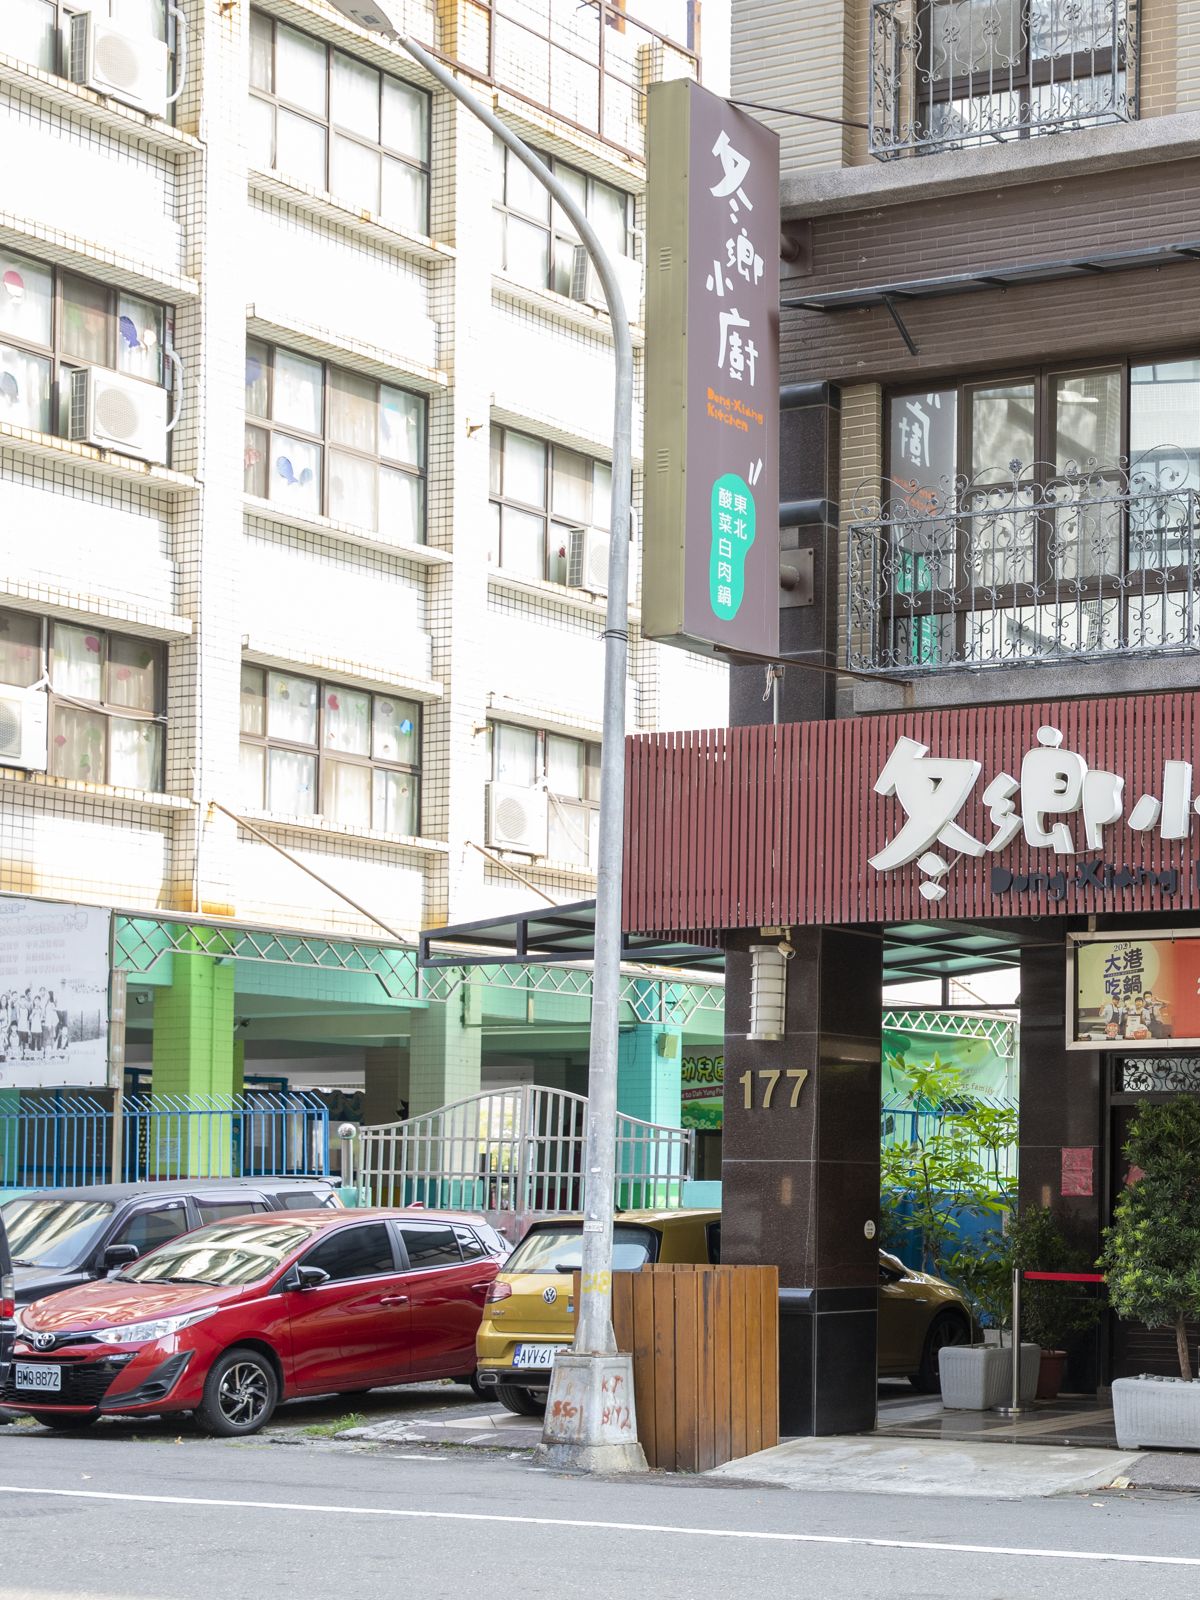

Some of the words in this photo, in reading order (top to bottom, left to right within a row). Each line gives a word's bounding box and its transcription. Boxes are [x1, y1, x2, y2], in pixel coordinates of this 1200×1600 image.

[706, 130, 764, 386] 冬鄉小廚
[707, 402, 749, 432] Kitchen
[733, 493, 748, 540] 東北
[717, 488, 732, 607] 酸菜白肉鍋
[991, 859, 1179, 900] Dong-Xiang
[1105, 948, 1143, 973] 大港
[1113, 942, 1132, 952] 2021
[1105, 975, 1143, 996] 吃鍋
[739, 1069, 808, 1109] 177
[520, 1349, 557, 1364] AVV-61
